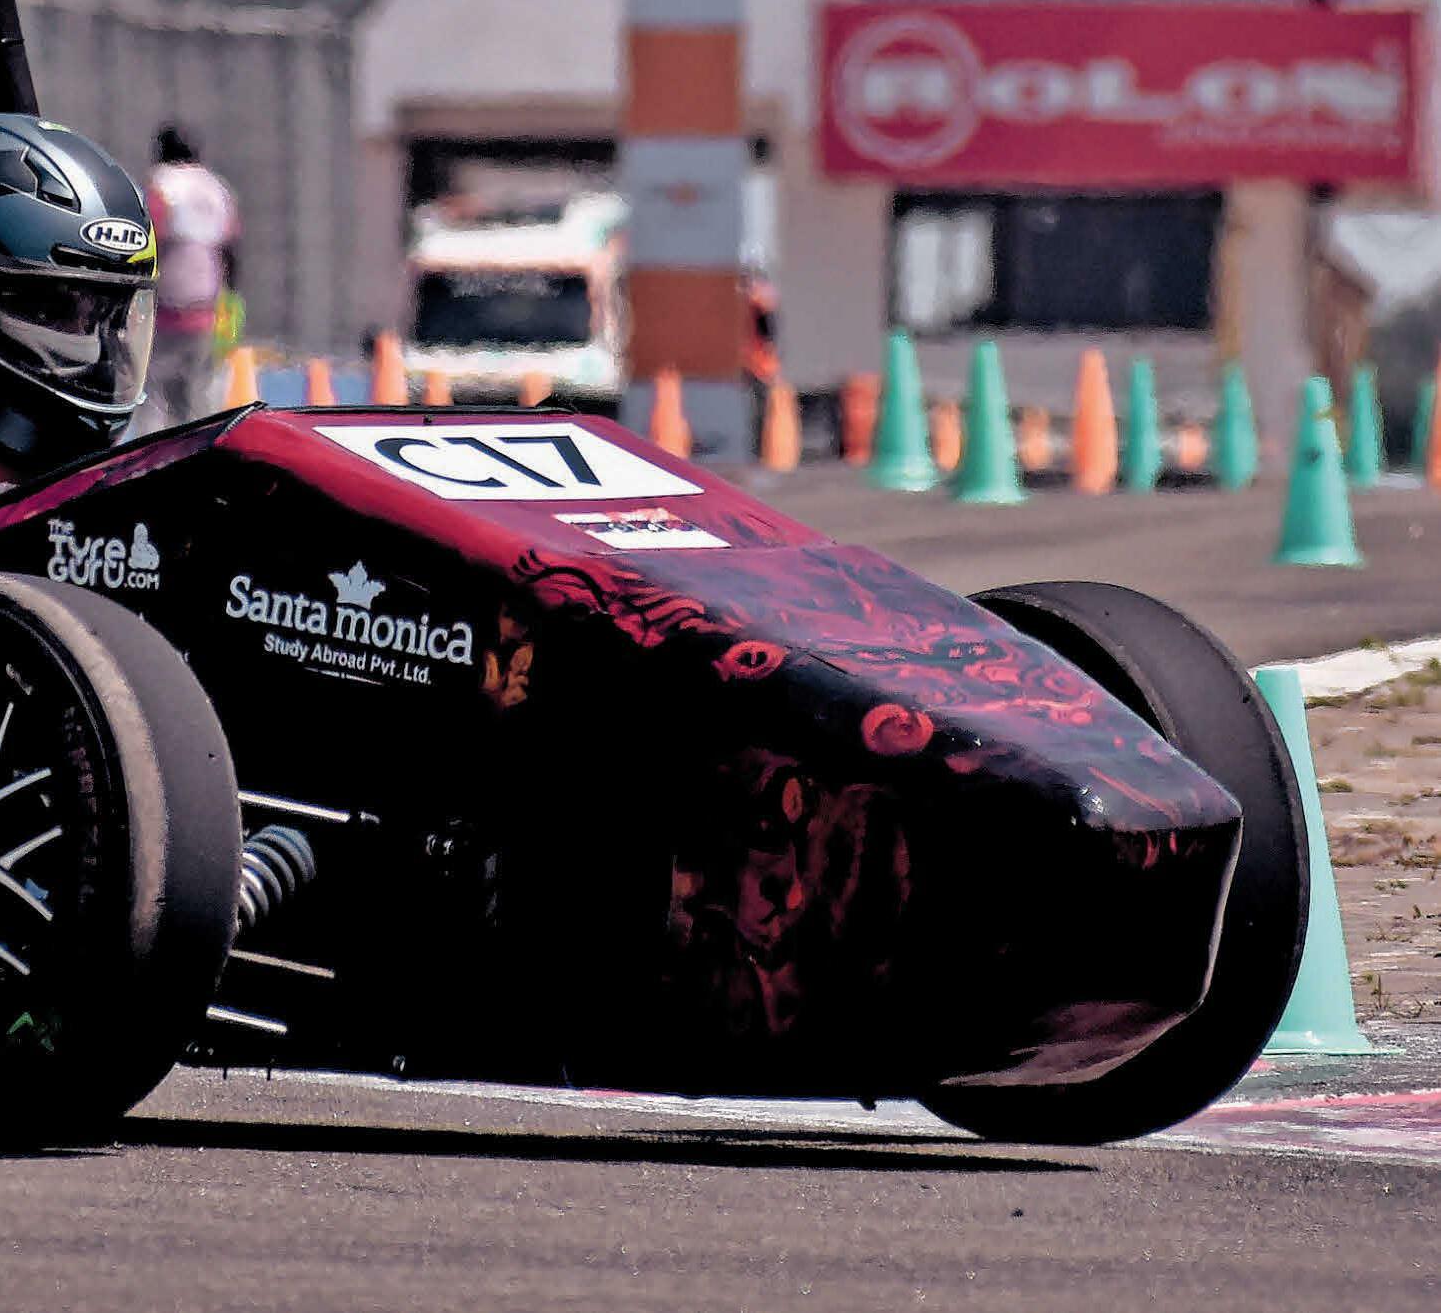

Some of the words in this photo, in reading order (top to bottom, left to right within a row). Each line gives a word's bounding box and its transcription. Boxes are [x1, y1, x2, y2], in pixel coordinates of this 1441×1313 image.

[95, 226, 143, 246] HJC
[374, 436, 602, 488] C17
[226, 575, 327, 635] Santa
[264, 633, 308, 662] Study
[310, 643, 366, 671] Abroad
[403, 662, 432, 685] Ltd.
